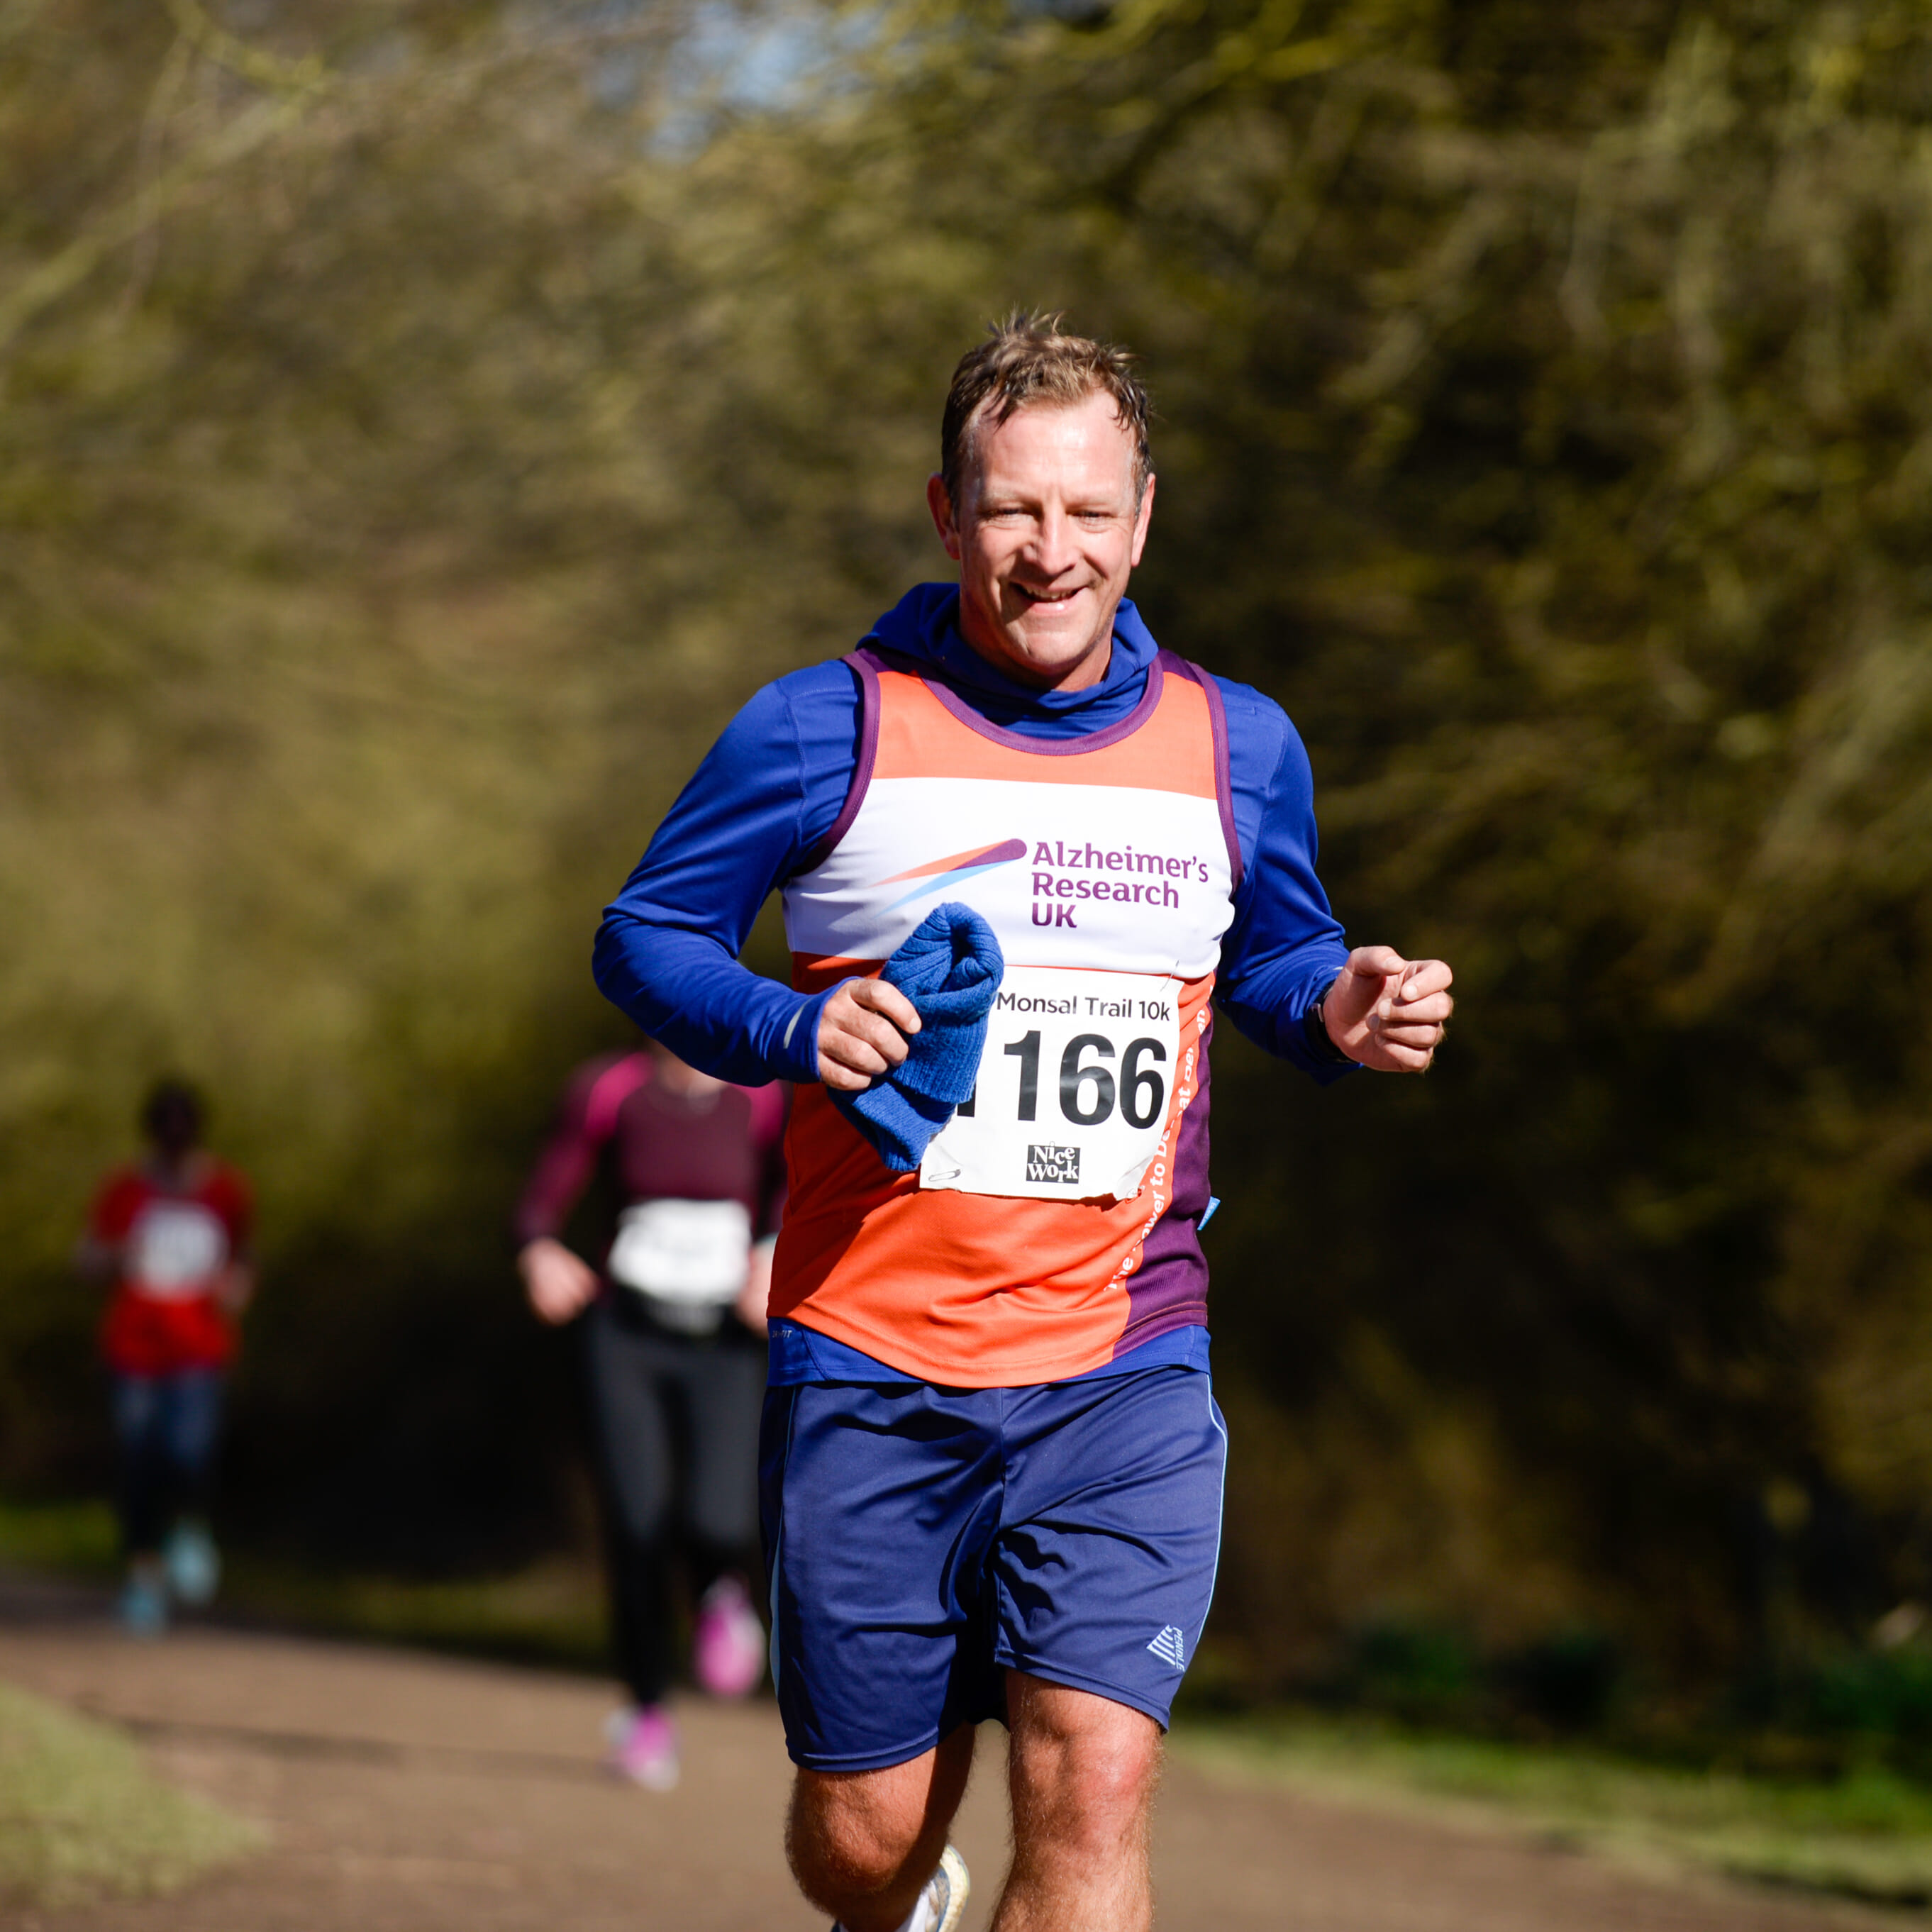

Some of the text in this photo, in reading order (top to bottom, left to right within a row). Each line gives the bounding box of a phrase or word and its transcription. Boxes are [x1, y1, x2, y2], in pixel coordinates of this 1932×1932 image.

[1033, 841, 1209, 882] Alzheimer's
[1032, 872, 1179, 909] Research
[1032, 902, 1077, 928] UK
[996, 992, 1170, 1021] Monsal Trail 10k
[957, 1030, 1167, 1129] 166
[1155, 1087, 1191, 1157] Deat
[1027, 1160, 1079, 1182] Work
[1033, 1141, 1075, 1165] Nice
[1150, 1162, 1166, 1187] to
[1133, 1190, 1165, 1251] ower
[1173, 1626, 1185, 1672] PENDLE
